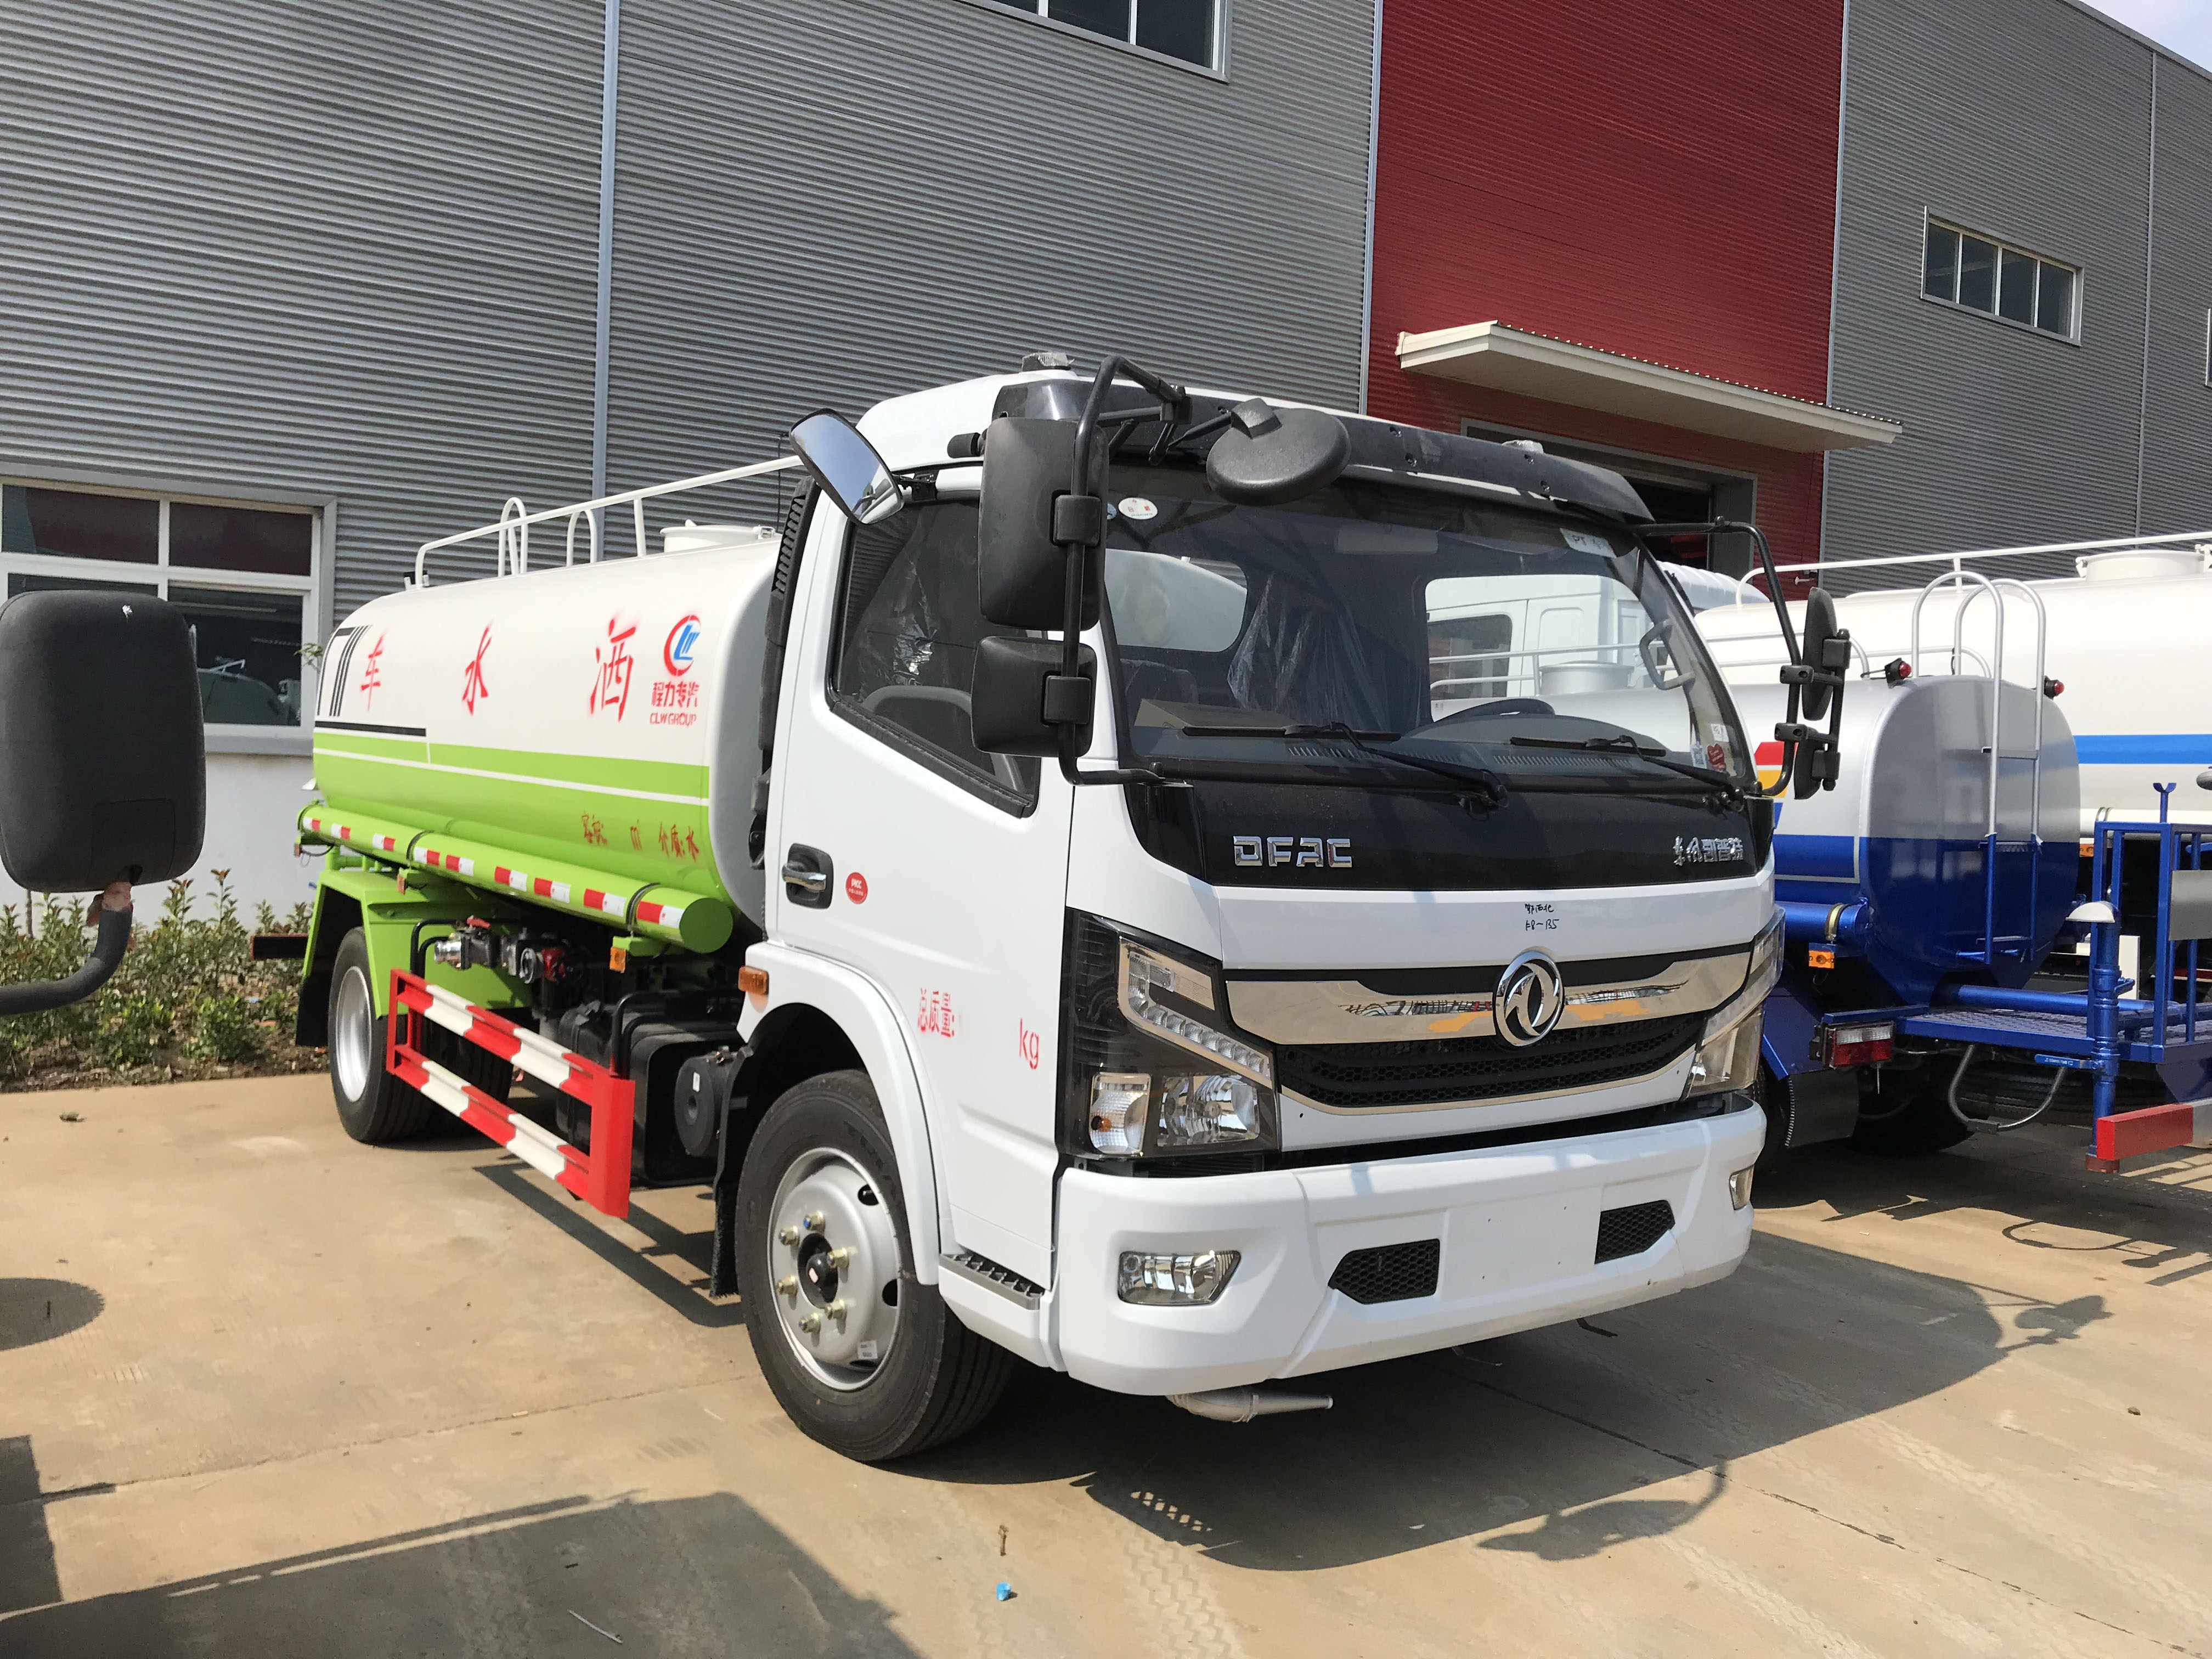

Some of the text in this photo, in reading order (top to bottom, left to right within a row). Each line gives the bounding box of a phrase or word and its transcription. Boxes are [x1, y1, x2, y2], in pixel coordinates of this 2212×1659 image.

[651, 681, 699, 708] 程力专汽
[1233, 836, 1352, 868] DFAC
[1019, 1018, 1039, 1070] kg
